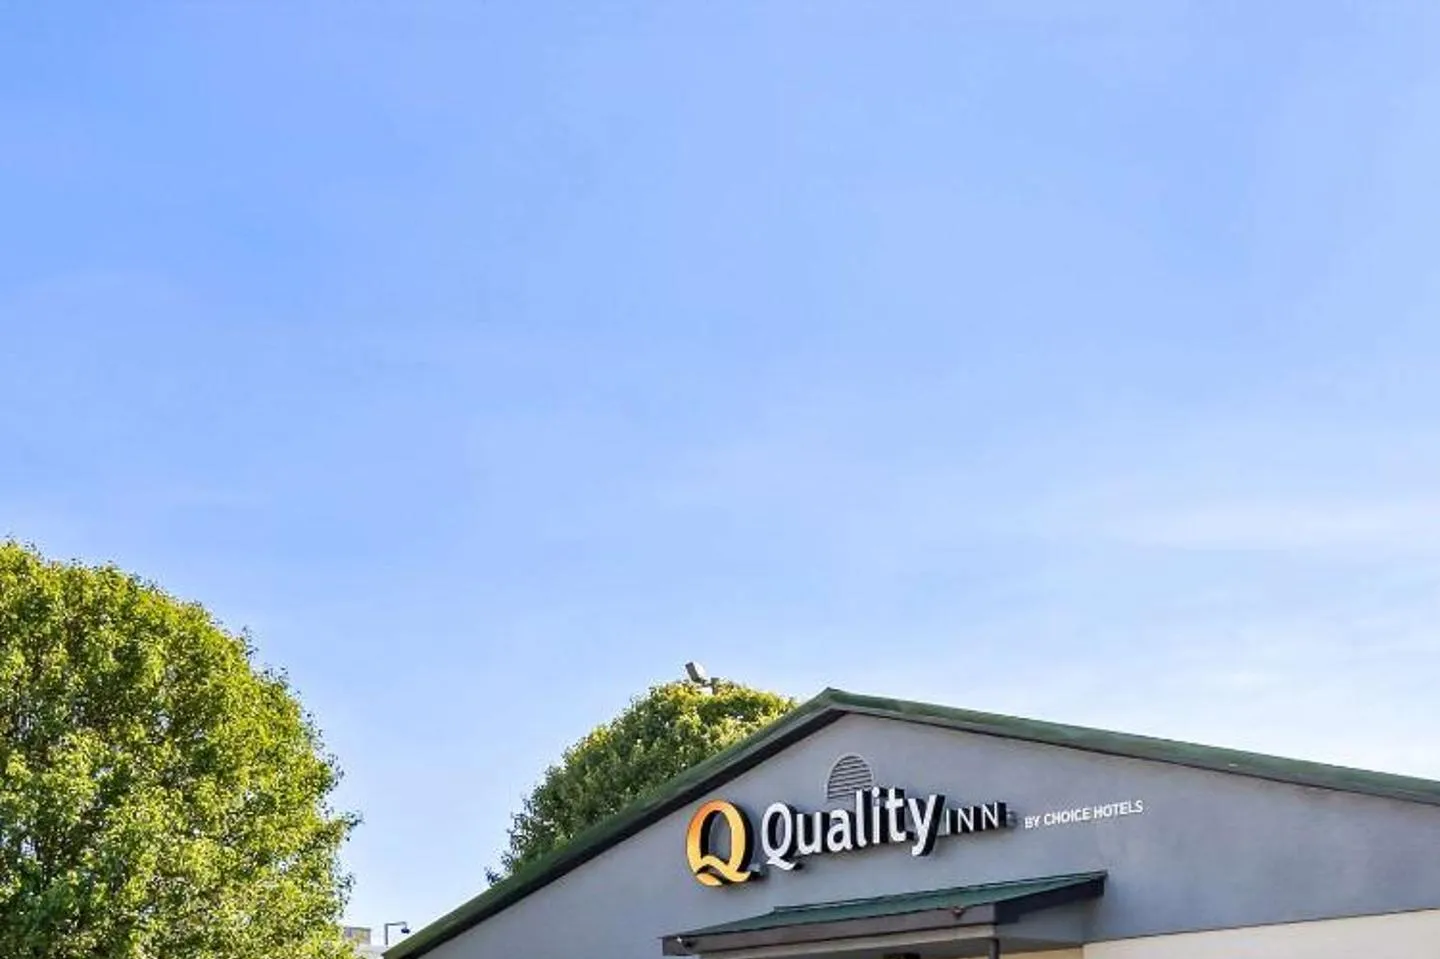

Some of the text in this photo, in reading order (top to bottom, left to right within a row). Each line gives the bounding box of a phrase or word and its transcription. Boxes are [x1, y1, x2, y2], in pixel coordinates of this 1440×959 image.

[686, 799, 752, 887] Q
[761, 786, 999, 871] Quality INN
[1024, 799, 1144, 829] BY CHOICE HOTELS
